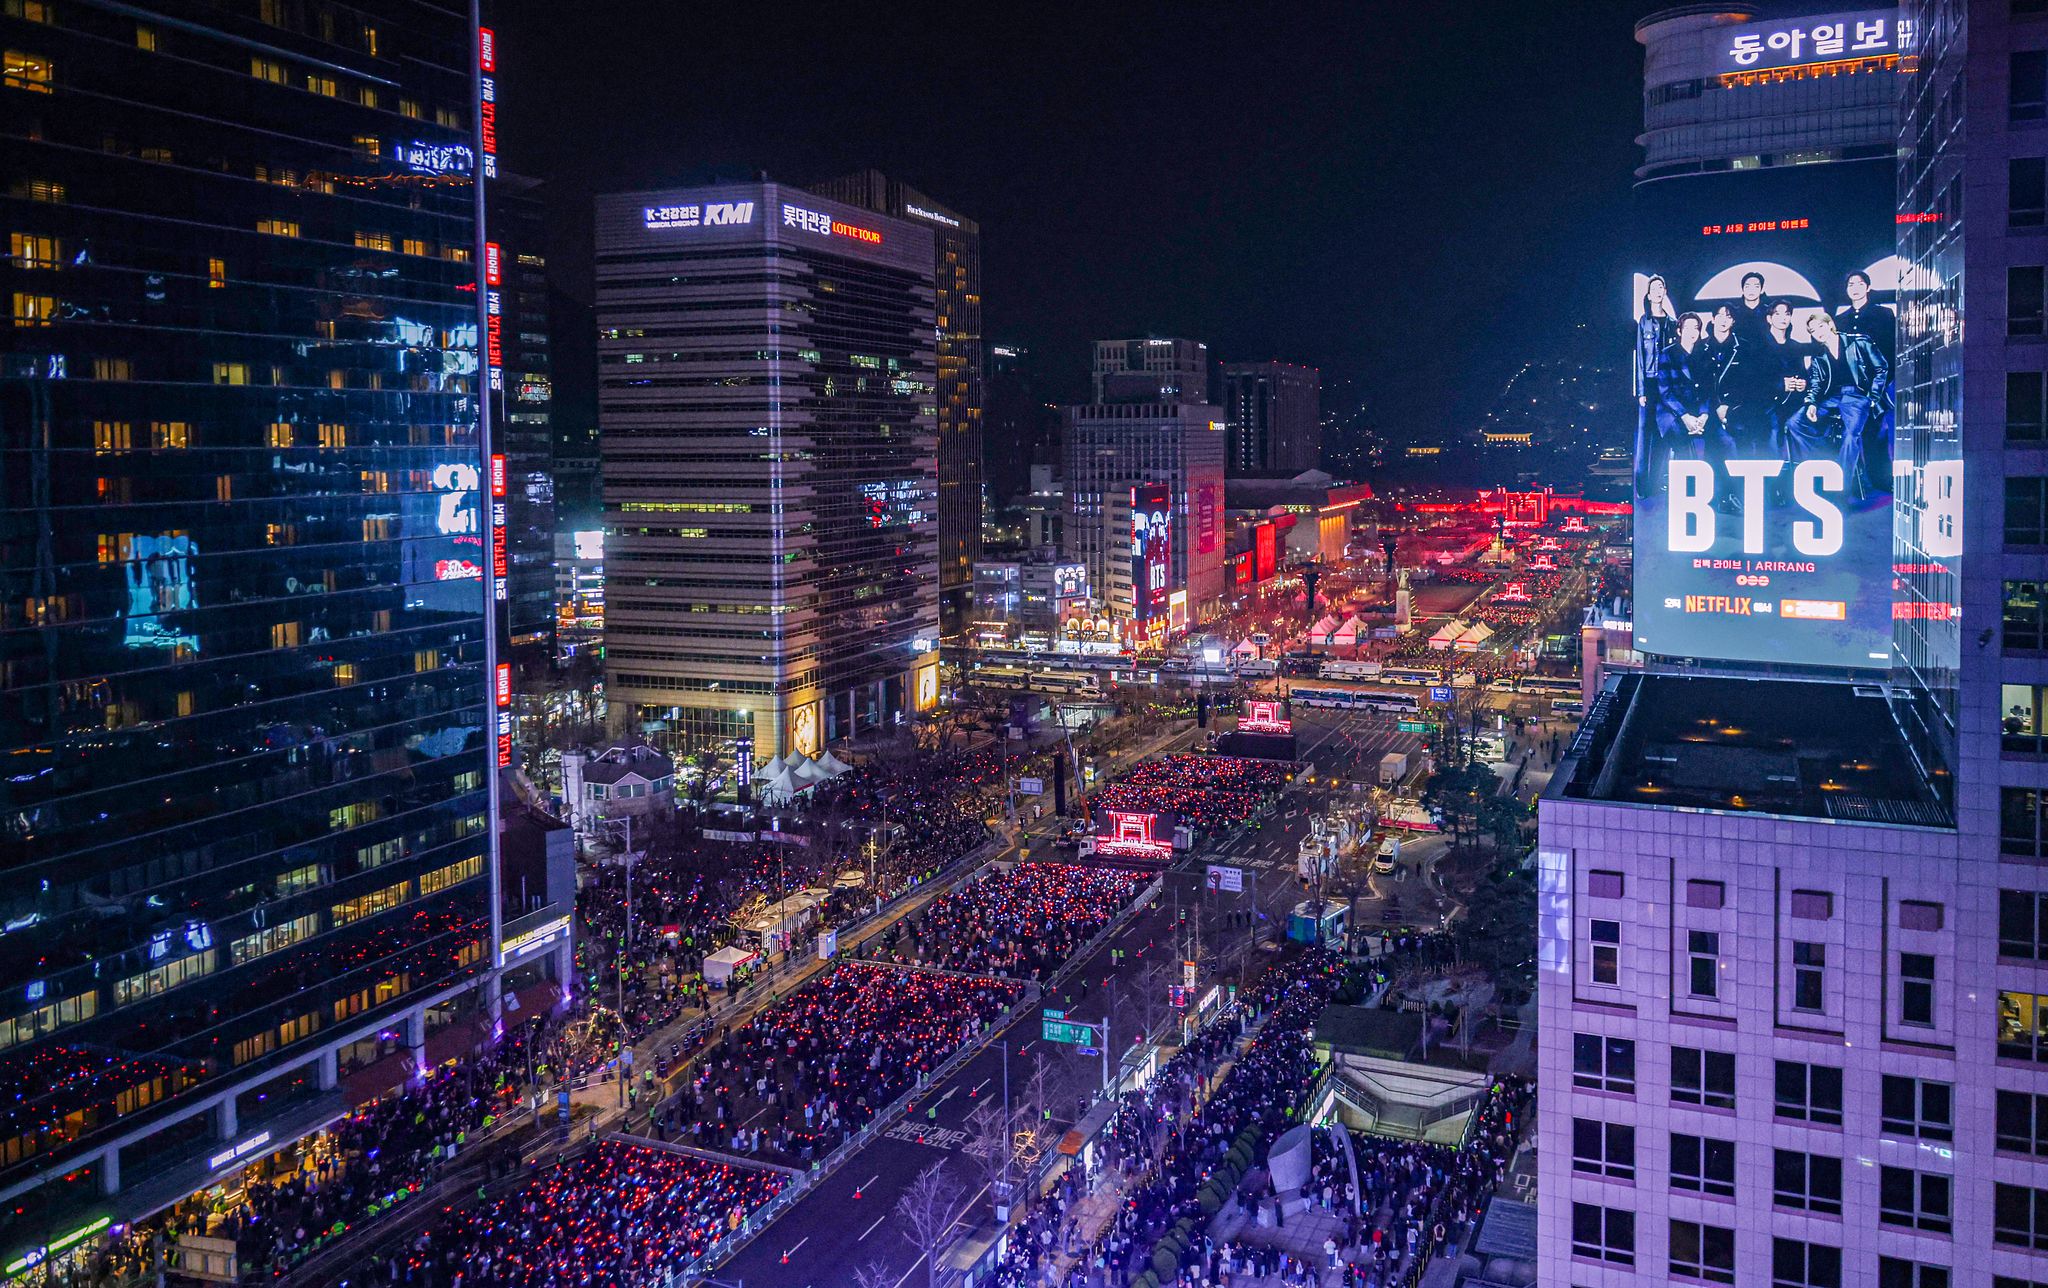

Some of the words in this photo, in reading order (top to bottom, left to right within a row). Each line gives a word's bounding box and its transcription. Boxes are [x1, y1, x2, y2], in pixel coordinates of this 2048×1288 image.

[1729, 19, 1889, 65] 동아일보
[482, 79, 495, 101] 에서
[482, 101, 497, 154] NETFLIX
[704, 203, 754, 226] KMI
[783, 204, 831, 235] 롯데관광
[832, 221, 857, 238] LOTTE
[858, 228, 881, 243] TOUR
[1726, 223, 1744, 234] 서울
[1748, 221, 1776, 232] 라이브
[1780, 218, 1809, 230] 이벤트
[488, 292, 500, 315] 에서
[488, 315, 502, 366] NETFLIX
[490, 368, 502, 390] 오직
[494, 503, 505, 525] 에서
[1667, 460, 1846, 557] BTS
[494, 526, 507, 576] NETFLIX
[1150, 563, 1166, 591] BTS
[1714, 559, 1742, 570] 라이브
[1755, 561, 1815, 573] ARIRANG
[495, 578, 507, 600] 오직
[1685, 595, 1751, 616] NETFLIX
[498, 711, 510, 735] 에서
